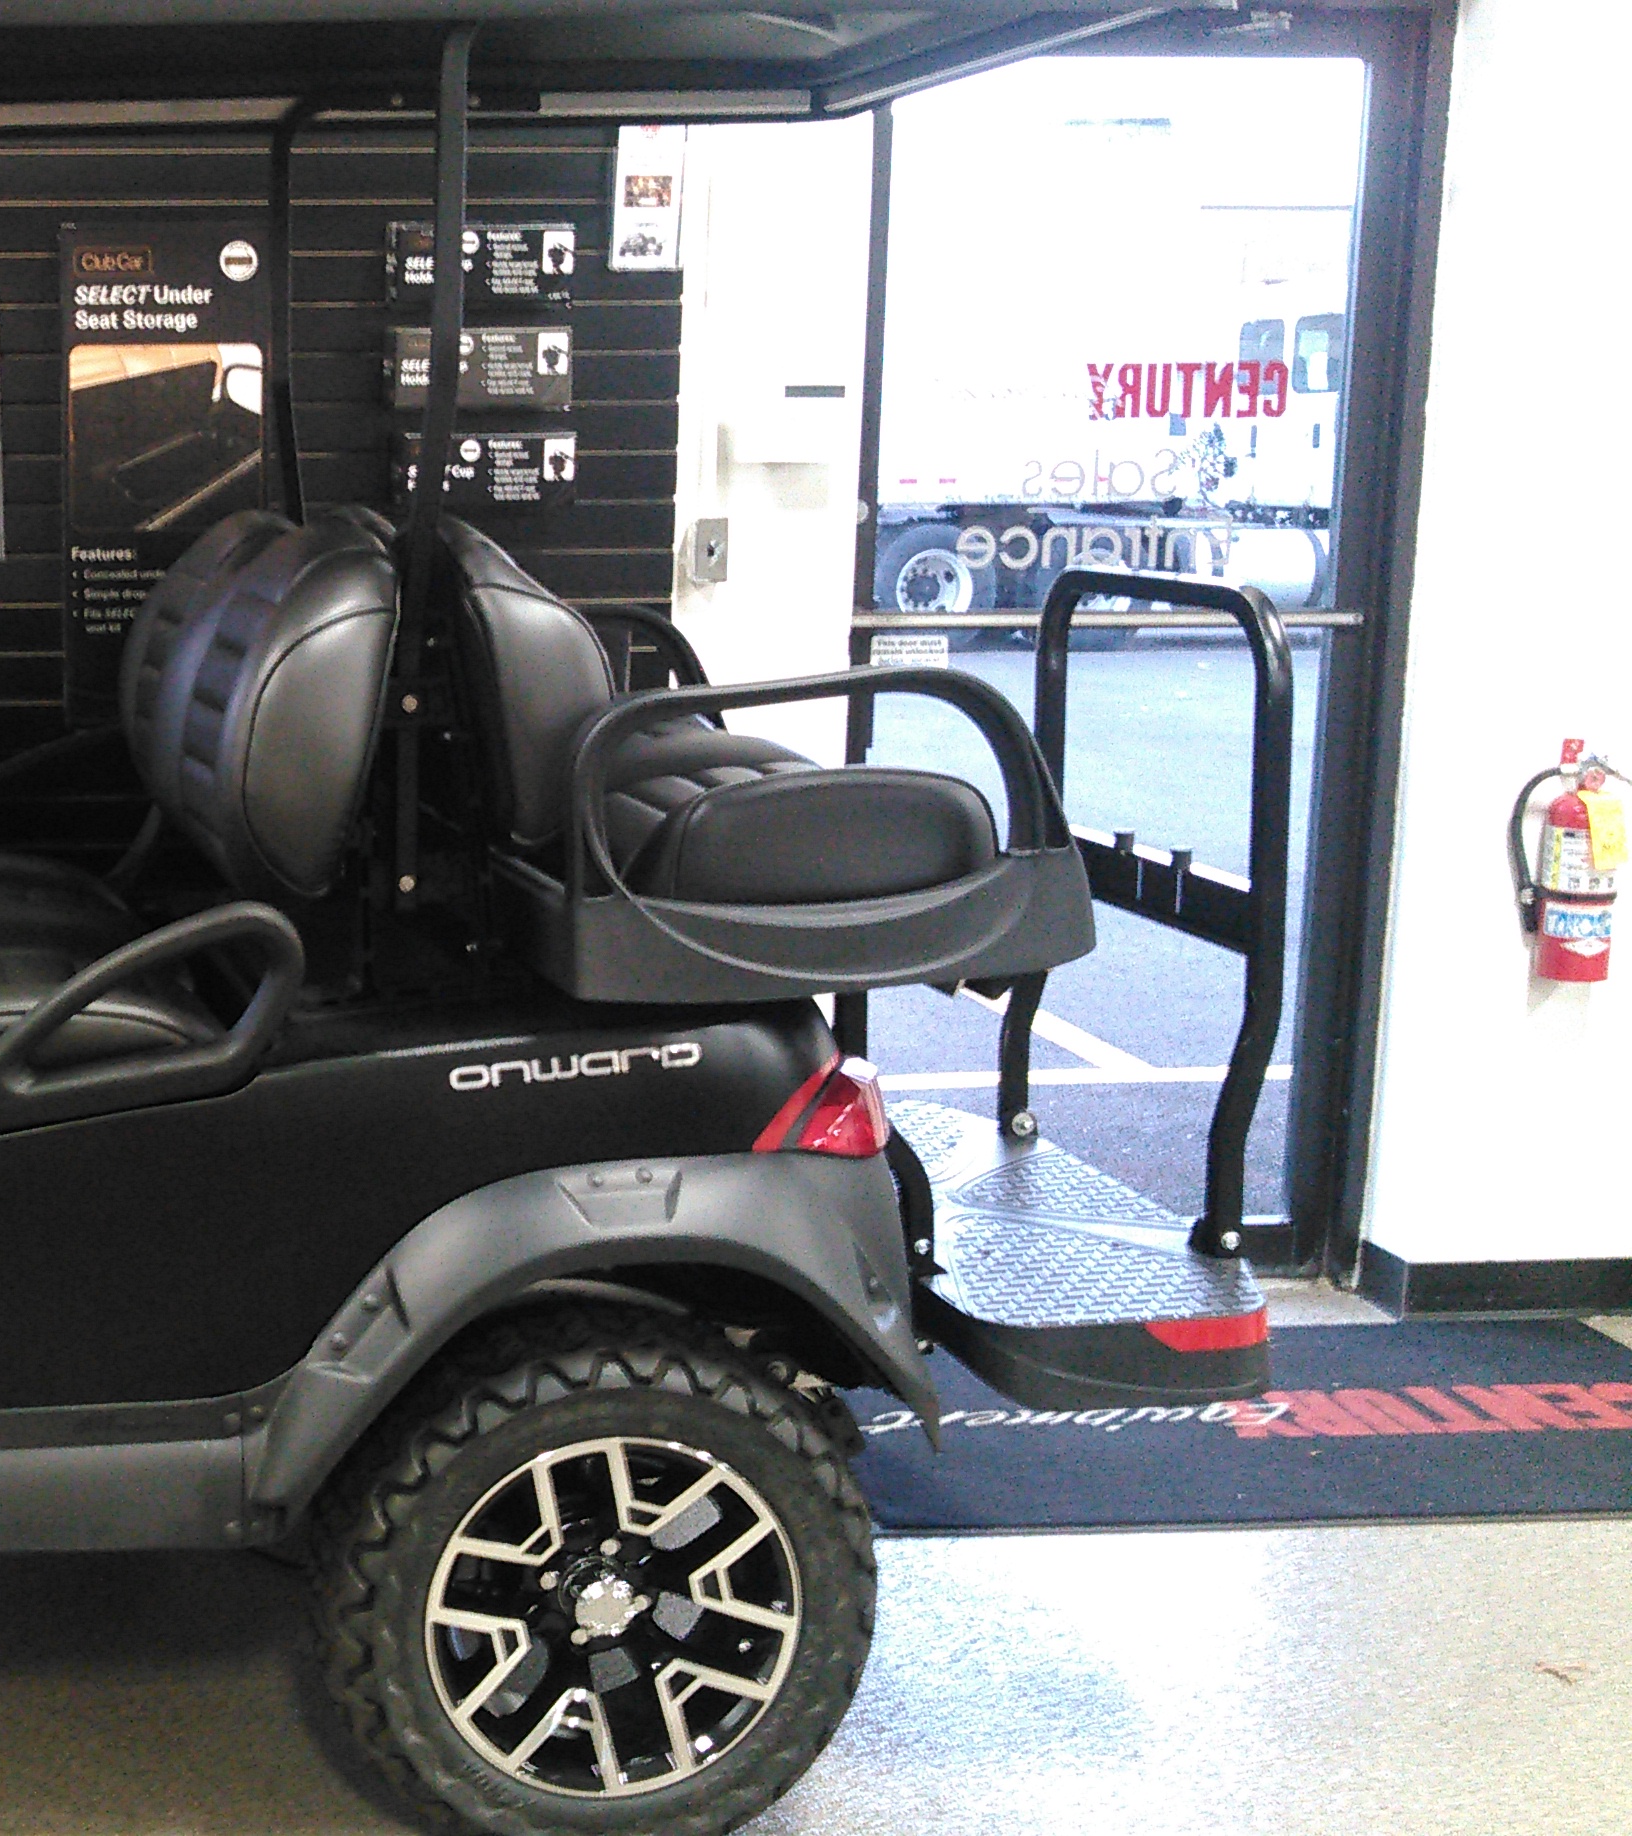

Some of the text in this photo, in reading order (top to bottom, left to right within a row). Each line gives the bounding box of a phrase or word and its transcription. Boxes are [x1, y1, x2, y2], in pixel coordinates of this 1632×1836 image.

[405, 256, 435, 271] SELE
[74, 284, 214, 306] SELECT Under
[75, 309, 199, 333] Seat Storage
[400, 358, 431, 373] SELE
